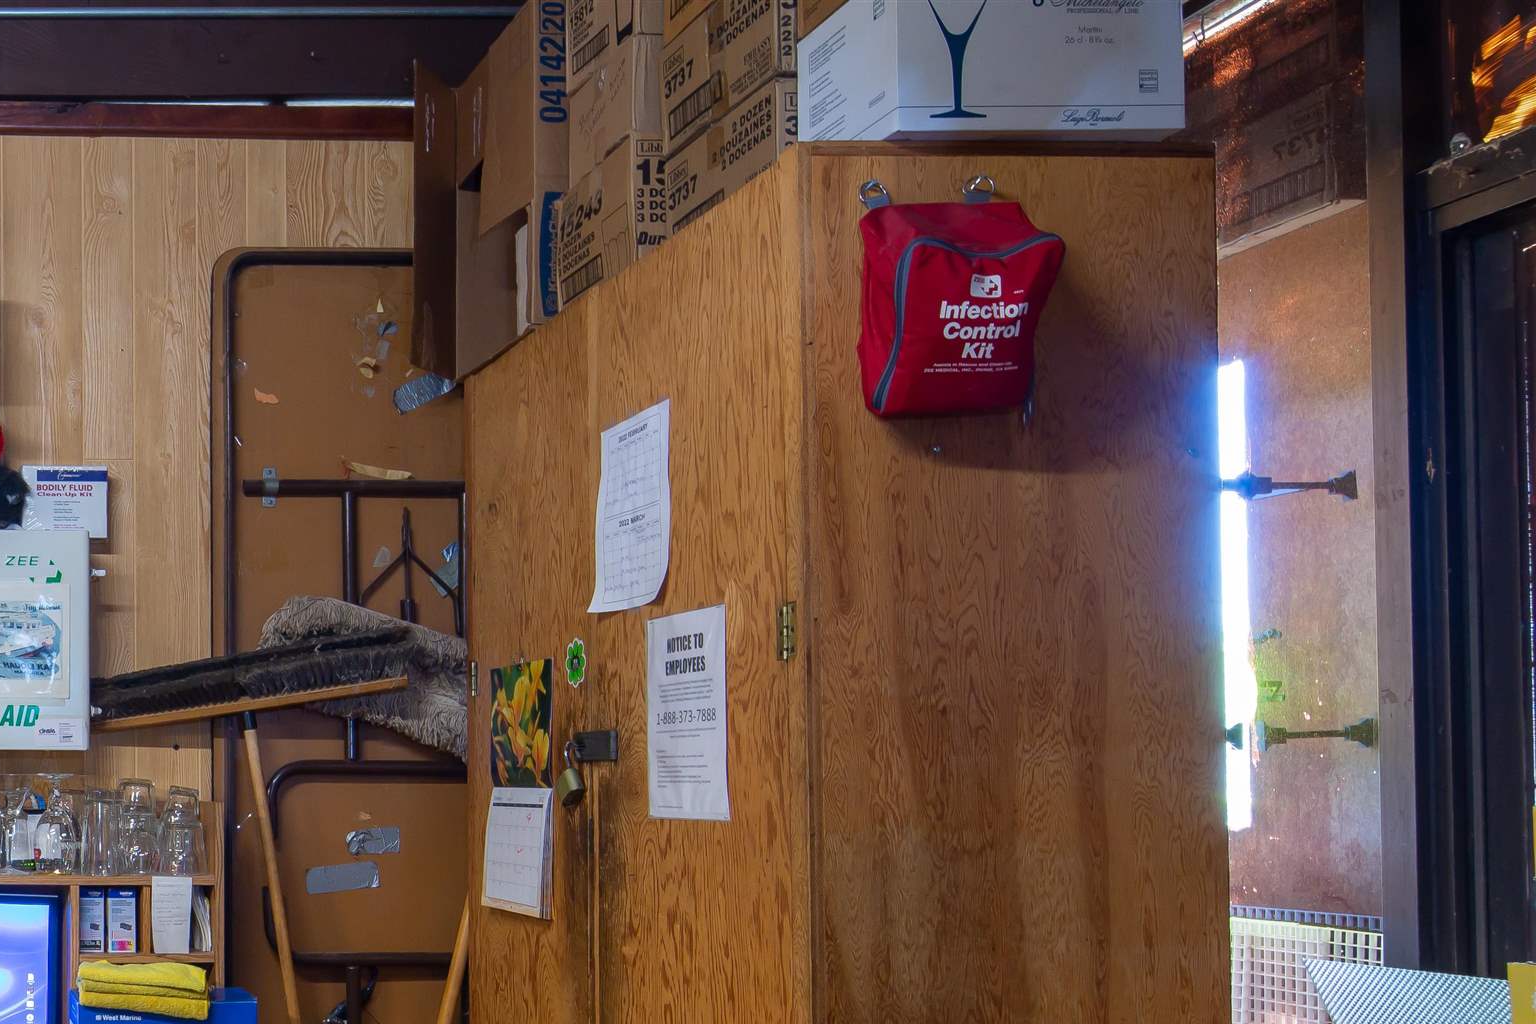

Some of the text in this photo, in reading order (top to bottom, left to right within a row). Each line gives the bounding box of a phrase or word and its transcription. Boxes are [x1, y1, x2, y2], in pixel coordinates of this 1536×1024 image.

[664, 58, 694, 100] 3737
[731, 120, 737, 134] 2
[739, 94, 772, 129] DOZEN
[720, 109, 772, 158] DOUZAINES
[640, 140, 664, 154] Libb
[728, 124, 772, 167] DOCENAS
[637, 188, 645, 198] 3
[668, 174, 698, 212] 3737
[637, 200, 645, 210] 3
[637, 212, 645, 222] 3
[940, 300, 1029, 320] Infection
[944, 320, 1021, 340] Control
[961, 342, 994, 358] Kit
[36, 484, 94, 492] BODILY FLUID
[5, 556, 40, 566] ZEE
[666, 632, 704, 654] NOTICE TO
[665, 655, 706, 676] EMPLOYEES
[0, 704, 40, 727] AID
[656, 708, 717, 726] 1-888-373-7888
